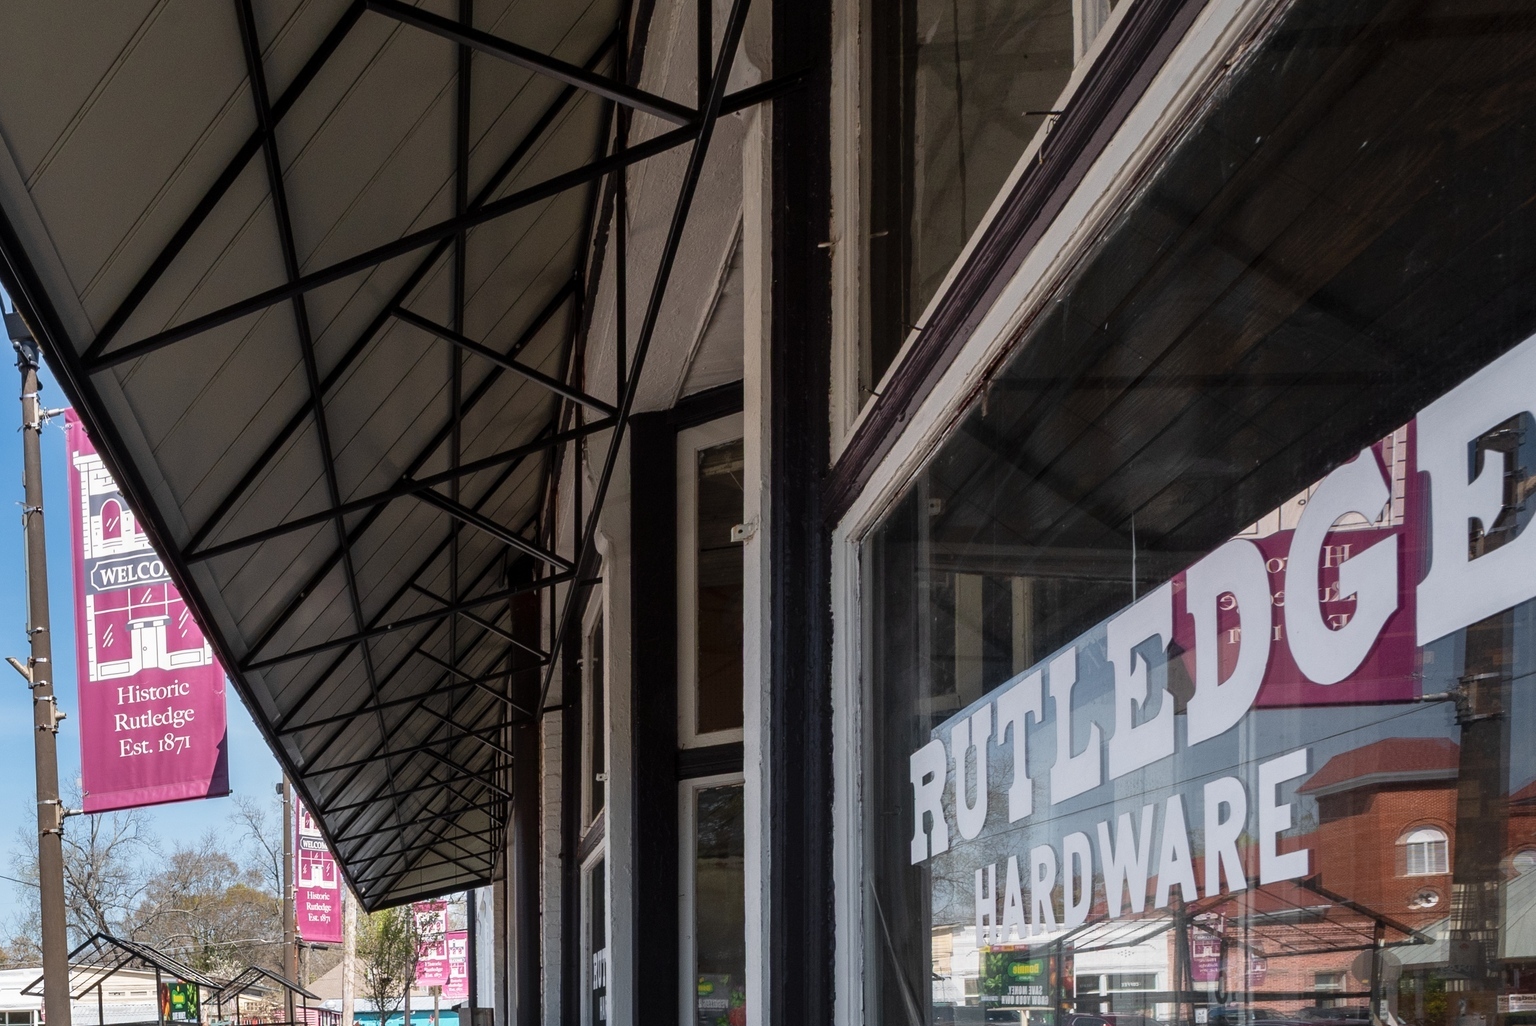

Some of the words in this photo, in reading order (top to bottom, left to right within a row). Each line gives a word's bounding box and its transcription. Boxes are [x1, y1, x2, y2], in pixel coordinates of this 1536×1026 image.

[100, 556, 171, 585] WELCO
[910, 332, 1536, 865] RUTLEDGE
[117, 679, 190, 705] Historic
[114, 707, 195, 733] Rutledge
[119, 739, 153, 758] Est.
[158, 733, 191, 756] 1871
[975, 748, 1312, 948] HARDWARE
[306, 890, 330, 901] Historic
[306, 902, 332, 912] Rutledge
[308, 913, 319, 921] Est.
